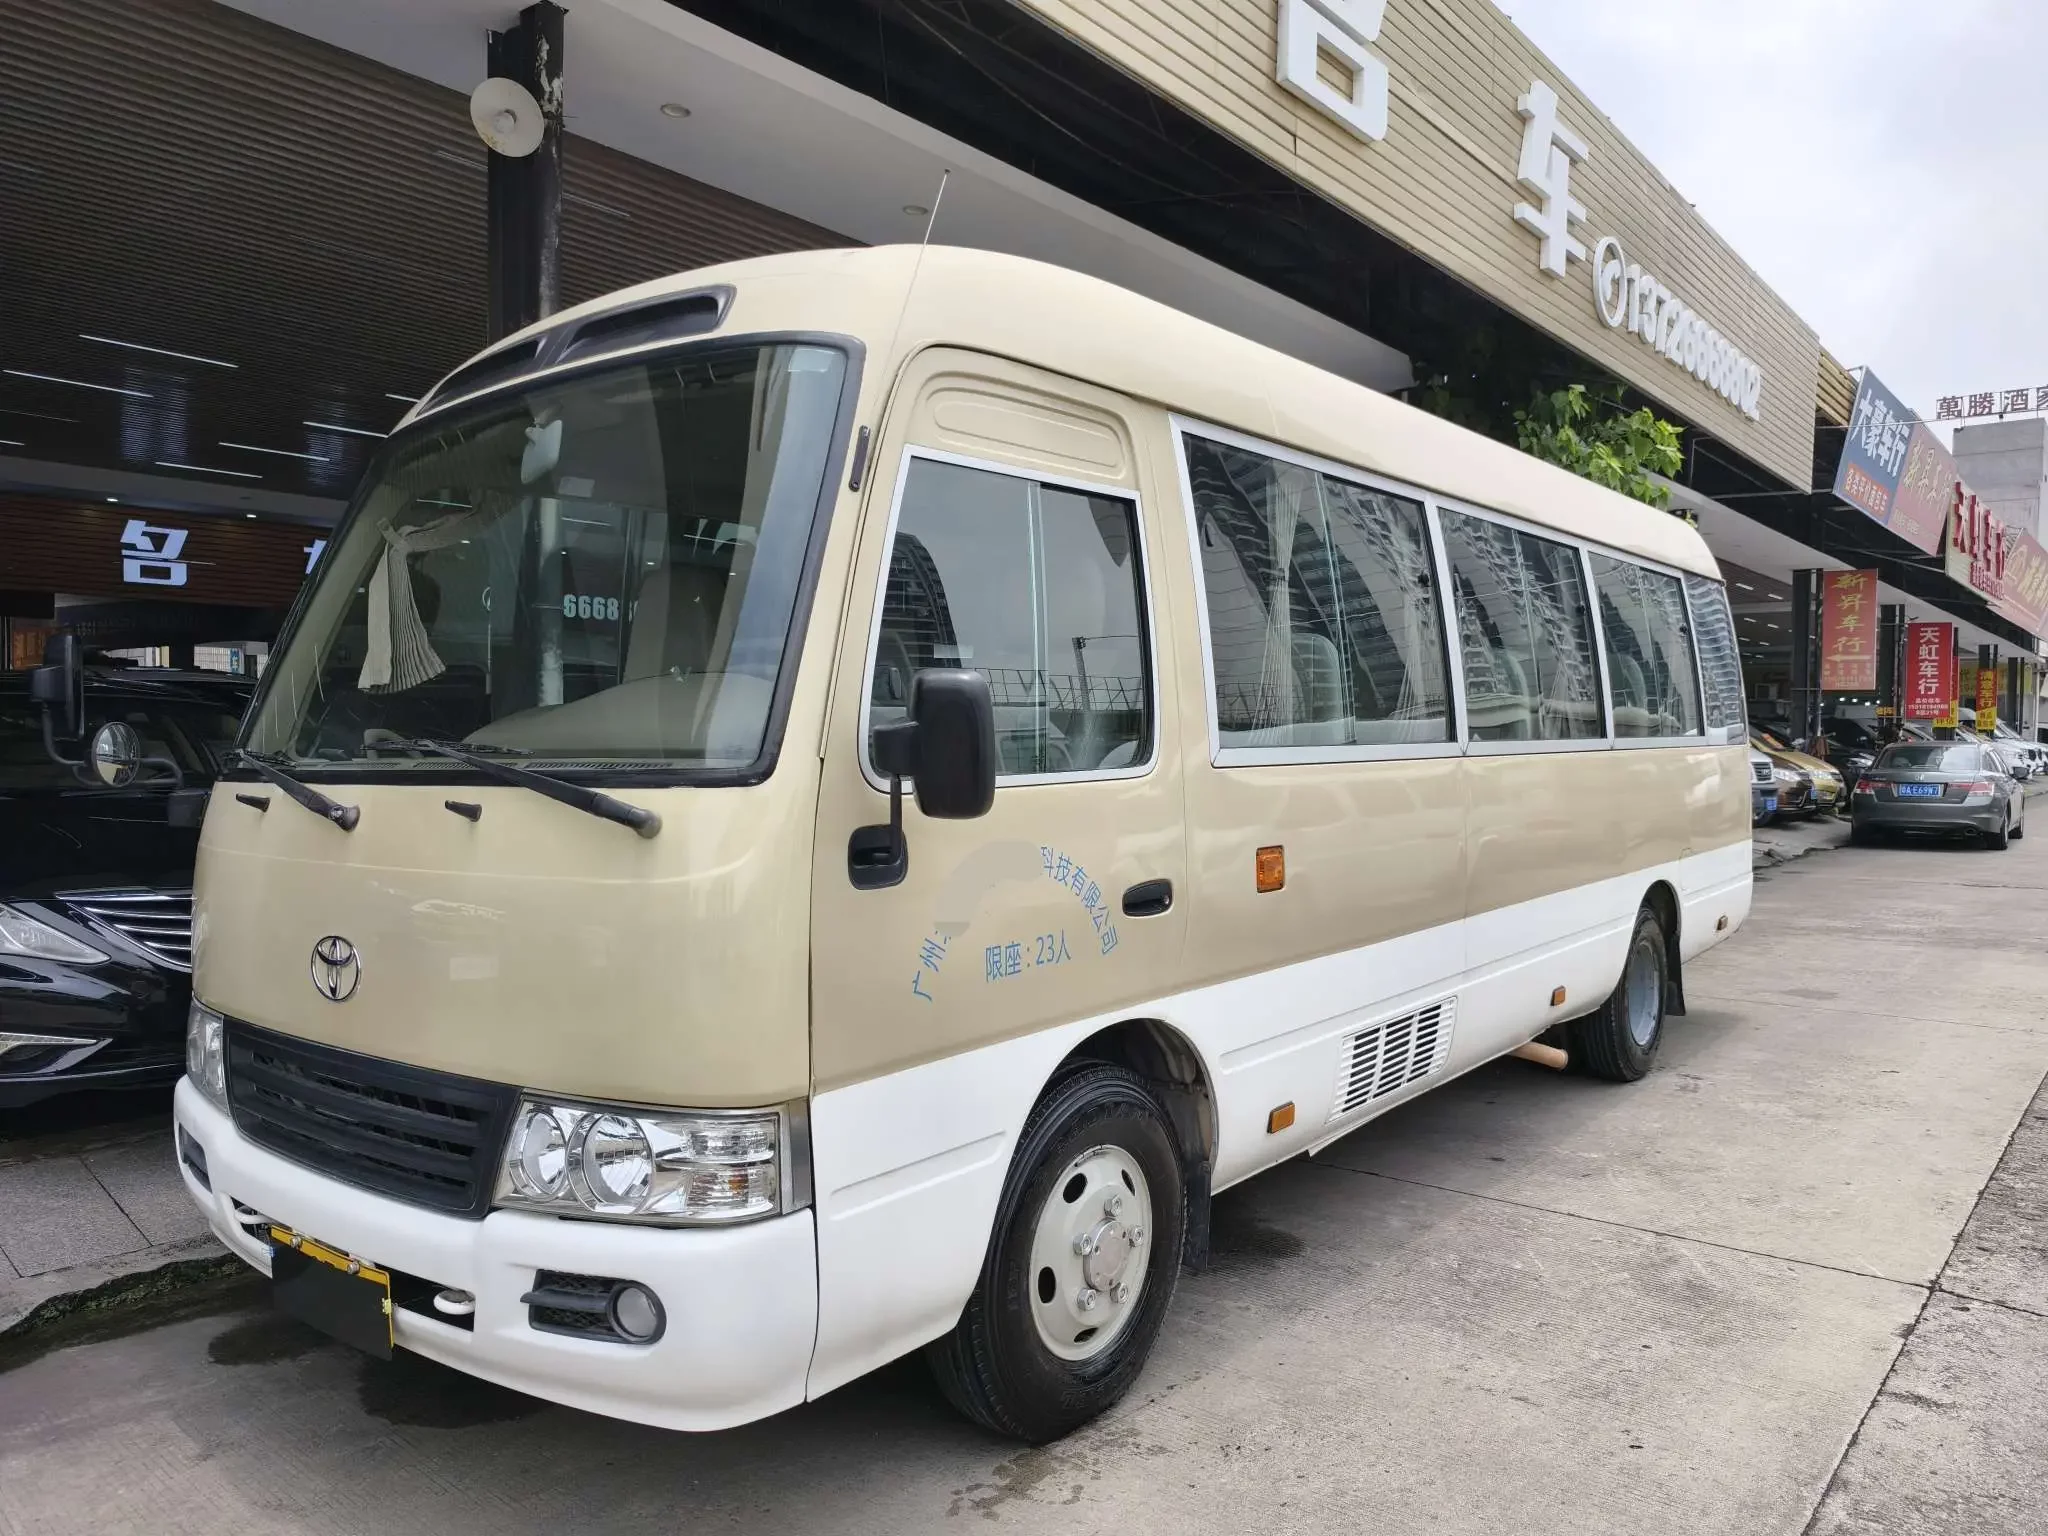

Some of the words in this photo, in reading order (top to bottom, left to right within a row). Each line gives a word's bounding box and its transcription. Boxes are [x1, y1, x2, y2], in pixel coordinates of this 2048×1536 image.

[1850, 388, 1910, 478] 大豪车行
[563, 593, 619, 621] 6668
[1917, 627, 1940, 694] 天虹车行
[1040, 846, 1118, 955] 科技有限公司
